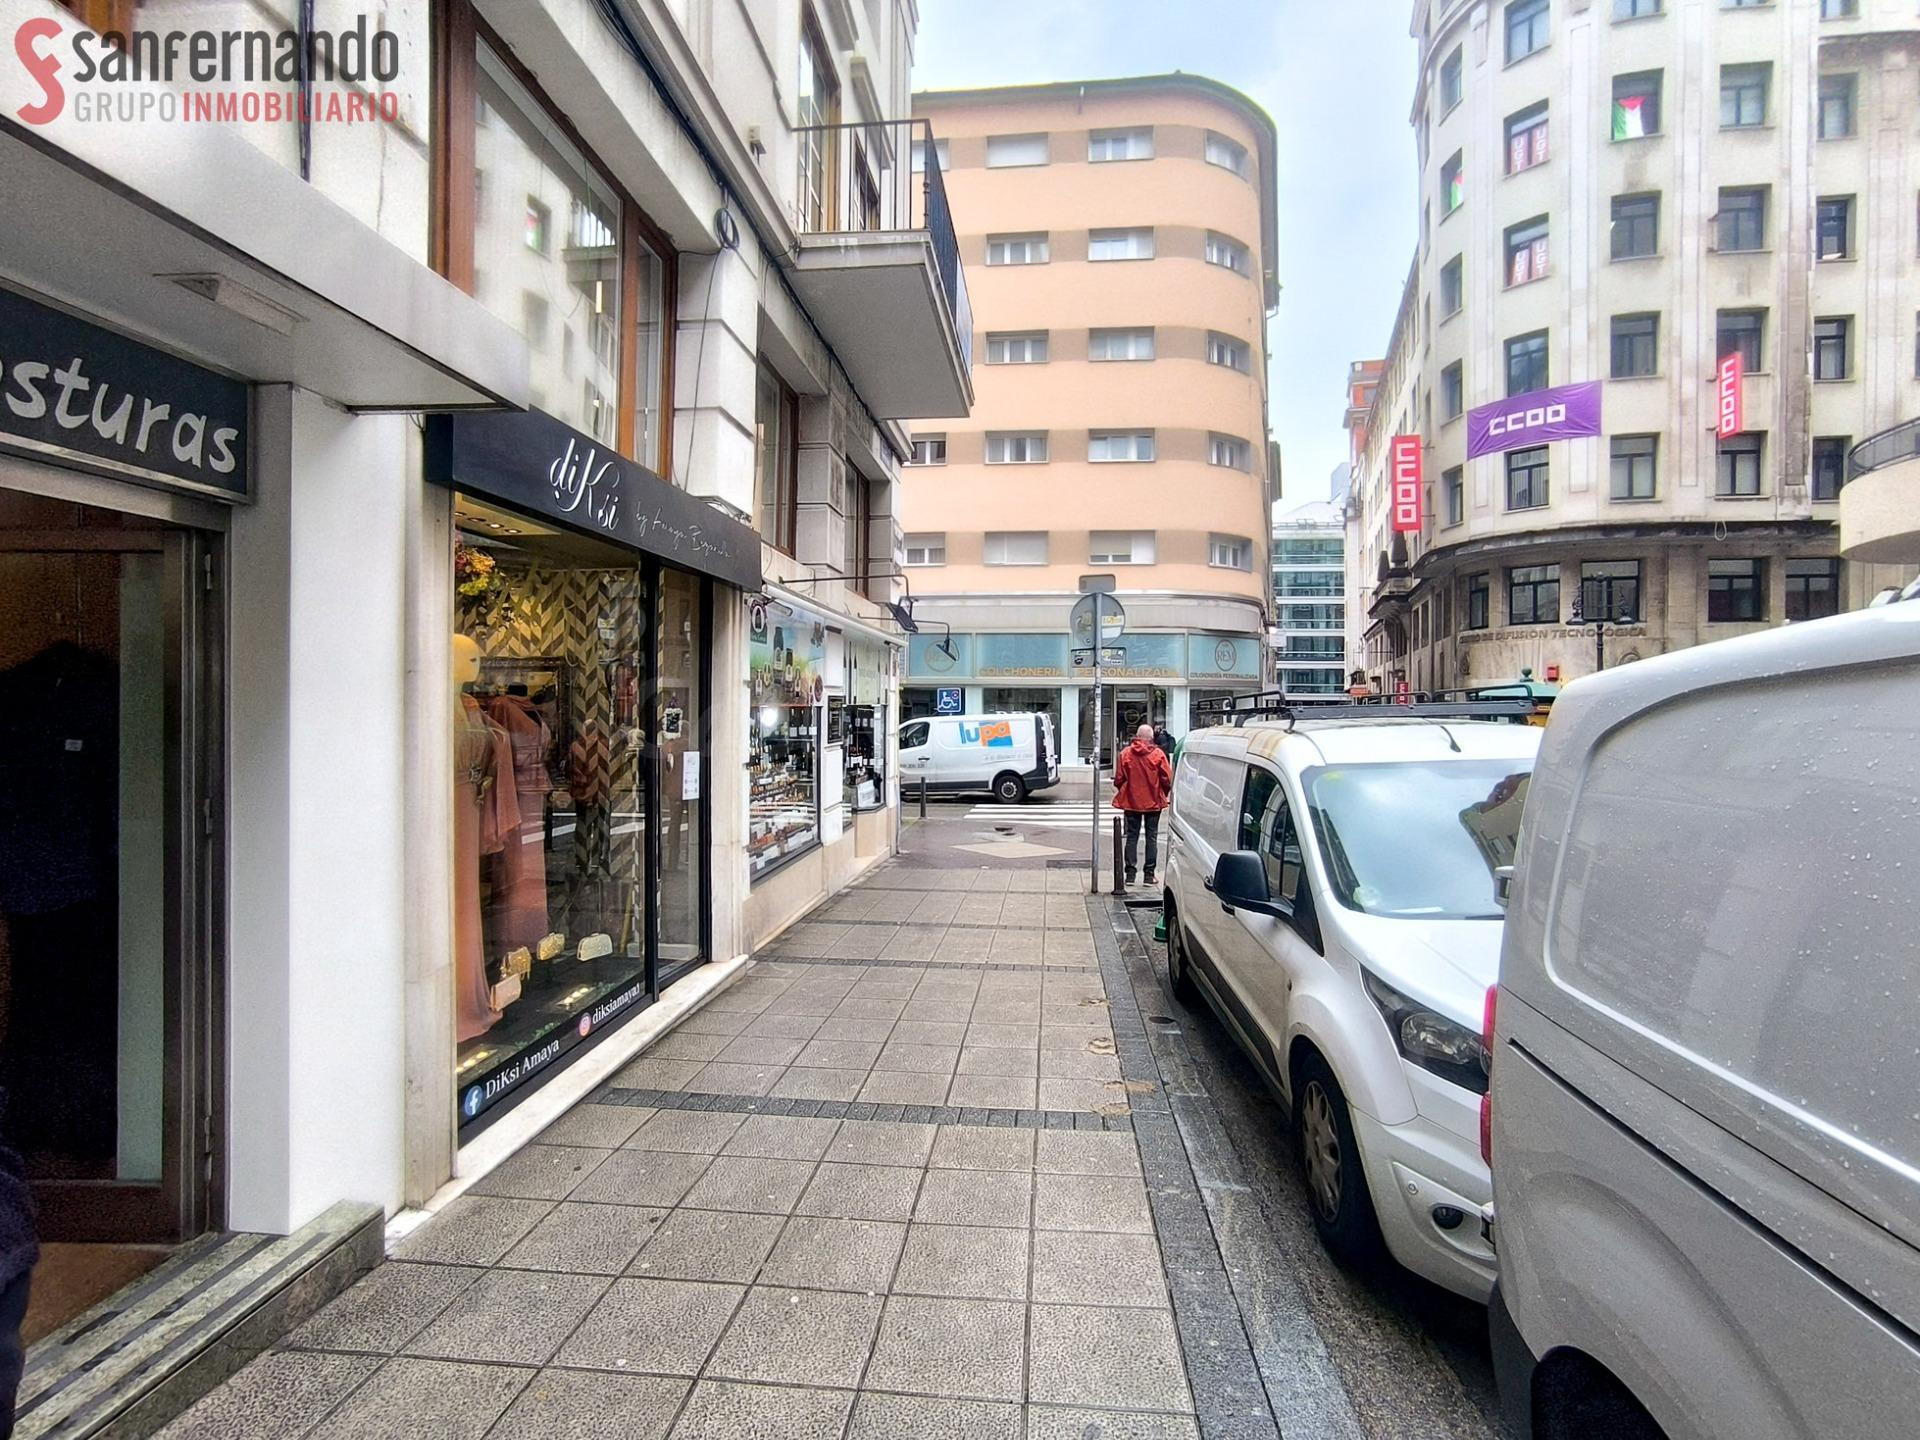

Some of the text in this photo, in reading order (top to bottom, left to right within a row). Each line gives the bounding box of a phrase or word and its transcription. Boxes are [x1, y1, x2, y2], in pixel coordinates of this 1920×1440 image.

[0, 358, 239, 473] sturas
[1489, 404, 1566, 436] CCOO
[1721, 359, 1735, 433] CCOO
[1396, 442, 1417, 523] CCOO
[1552, 625, 1647, 638] TECNOÓGICA
[959, 720, 1012, 747] lupa
[486, 1039, 560, 1099] DiKsi Amaya
